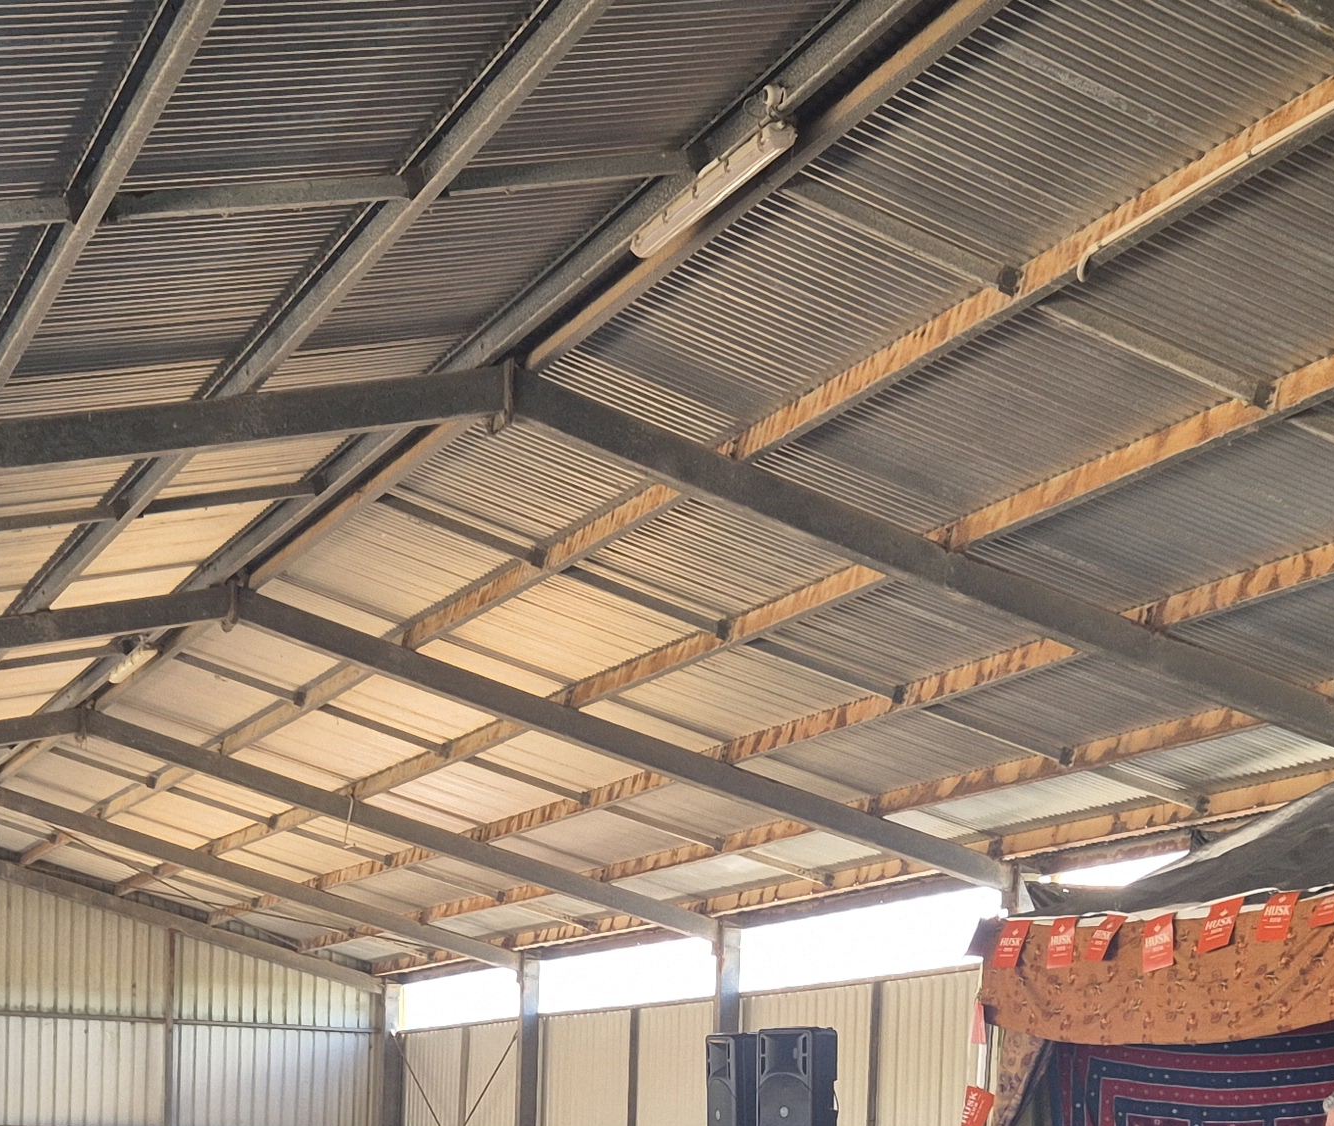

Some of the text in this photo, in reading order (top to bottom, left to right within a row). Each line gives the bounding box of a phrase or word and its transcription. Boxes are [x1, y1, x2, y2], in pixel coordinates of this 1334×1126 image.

[1264, 904, 1291, 916] HUSK
[1205, 915, 1234, 930] HUSK
[1000, 937, 1022, 946] HUSK
[1050, 934, 1072, 946] HUSK
[1145, 931, 1171, 948] HUSK
[961, 1090, 978, 1124] HUSK
